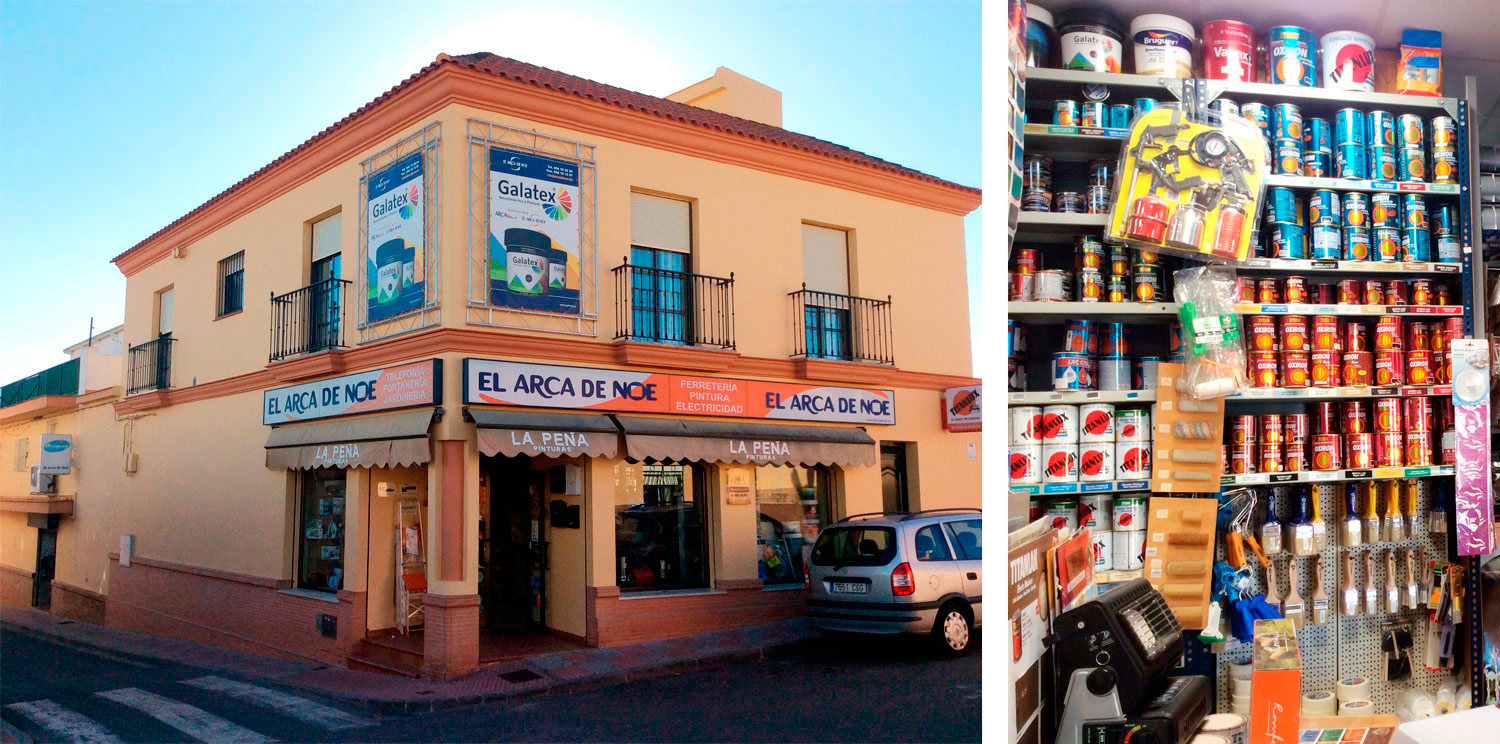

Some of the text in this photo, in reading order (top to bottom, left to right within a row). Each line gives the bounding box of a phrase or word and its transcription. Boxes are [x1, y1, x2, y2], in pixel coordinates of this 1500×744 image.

[498, 180, 556, 203] Galatex
[372, 193, 408, 218] Galatex
[478, 372, 657, 401] EL ARCA DE NOE
[680, 380, 738, 392] FERRETERÍA
[268, 380, 377, 415] EL ARCA DE NOE
[690, 392, 730, 402] PINTURA
[766, 392, 890, 416] EL ARCA DE NOE
[676, 402, 743, 414] ELECTRICIDAD
[1082, 410, 1114, 436] TITANLUX
[511, 431, 589, 447] LA PEÑA
[729, 440, 790, 455] LA PEÑA
[315, 443, 360, 459] LA PEÑA
